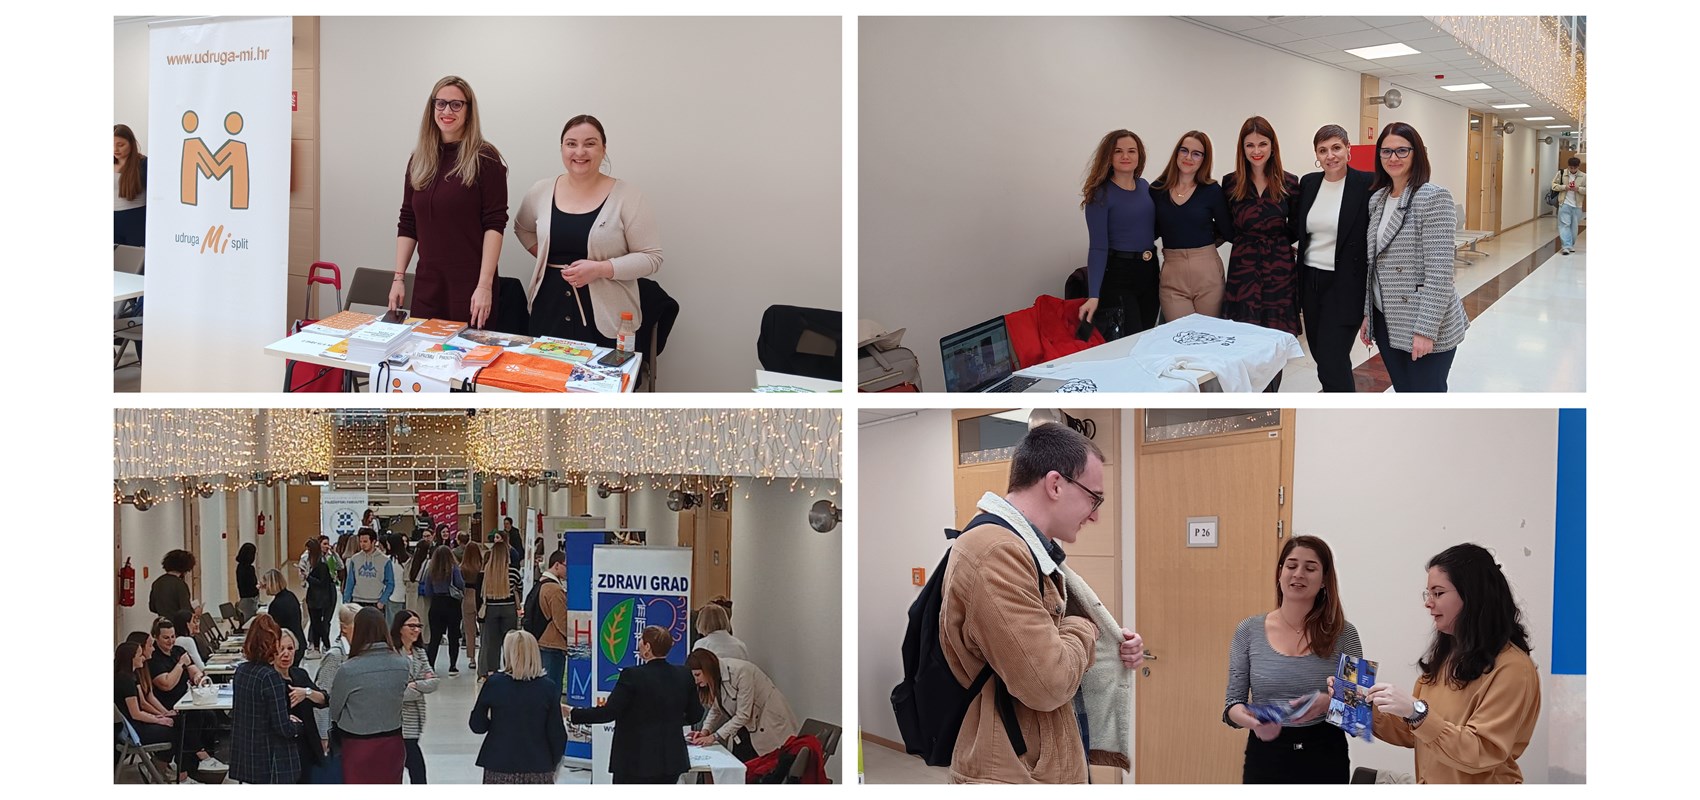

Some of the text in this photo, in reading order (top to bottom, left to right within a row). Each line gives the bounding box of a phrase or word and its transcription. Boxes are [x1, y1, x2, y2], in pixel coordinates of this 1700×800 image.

[166, 46, 270, 65] www.udruga-mi.hr
[174, 224, 249, 254] udruga Mi split
[1194, 527, 1211, 537] P 26
[597, 573, 647, 590] ZDRAVI
[650, 575, 689, 592] GRAD
